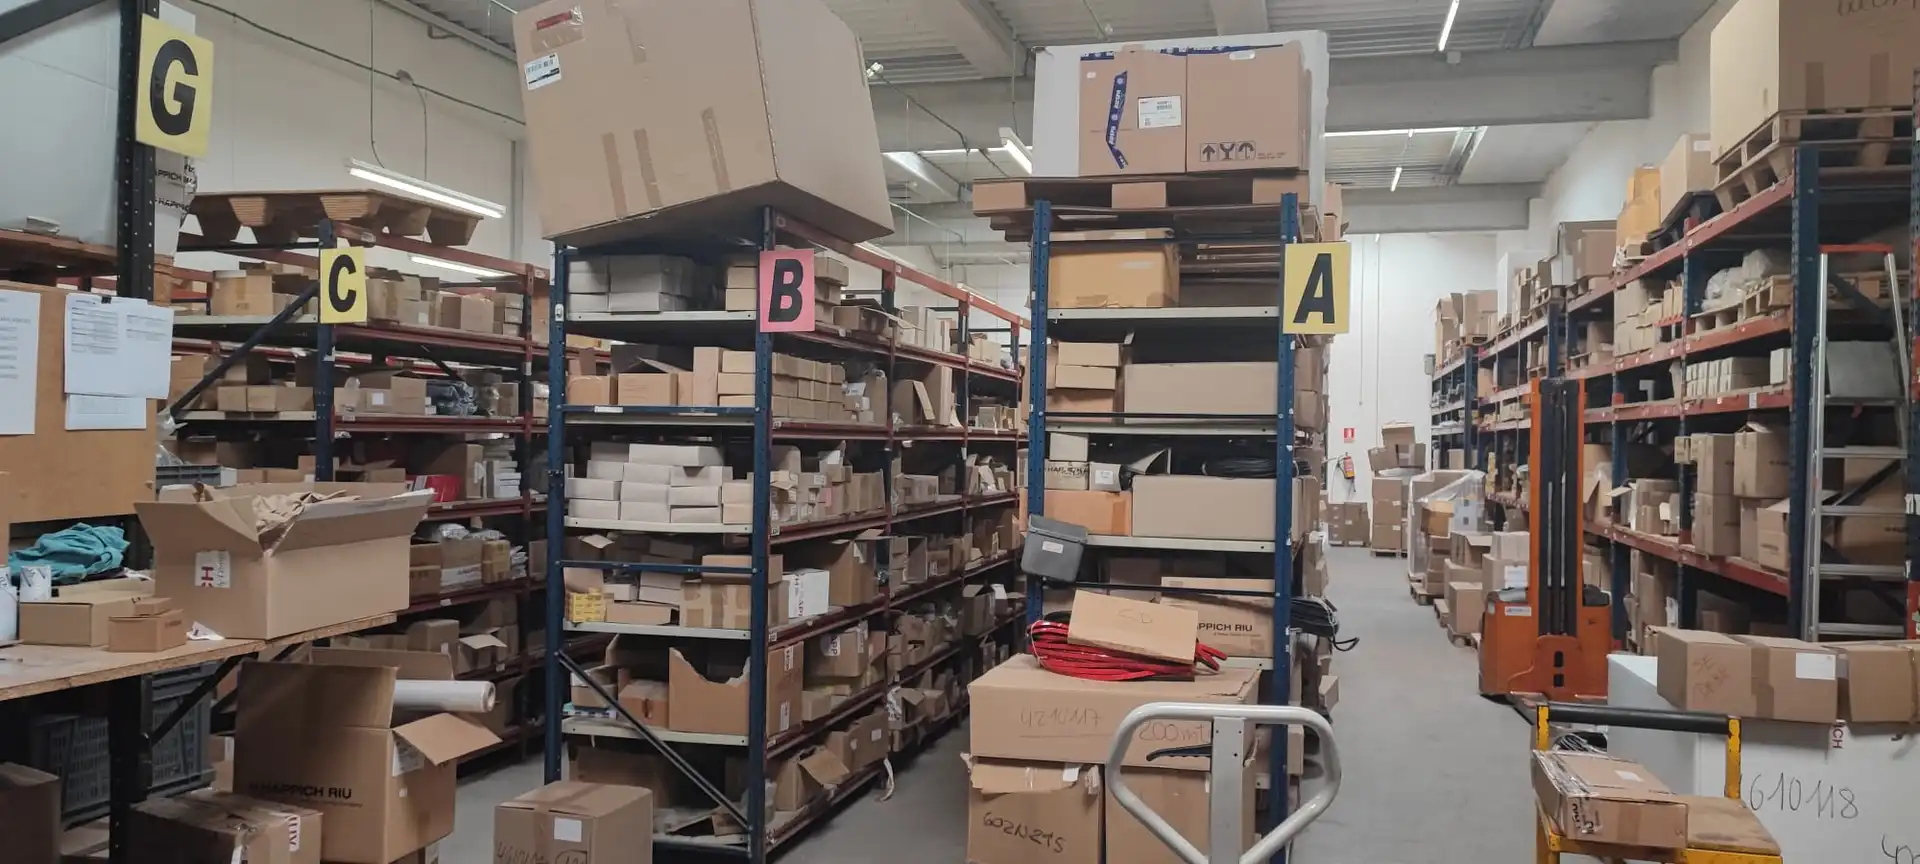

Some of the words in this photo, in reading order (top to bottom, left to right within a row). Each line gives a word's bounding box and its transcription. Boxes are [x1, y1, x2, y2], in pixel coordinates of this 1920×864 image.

[149, 39, 199, 136] G
[327, 254, 358, 313] C
[768, 259, 804, 322] B
[1292, 253, 1336, 325] A
[1197, 622, 1232, 632] PPICH
[1234, 623, 1253, 632] RIU
[328, 787, 352, 799] RIU
